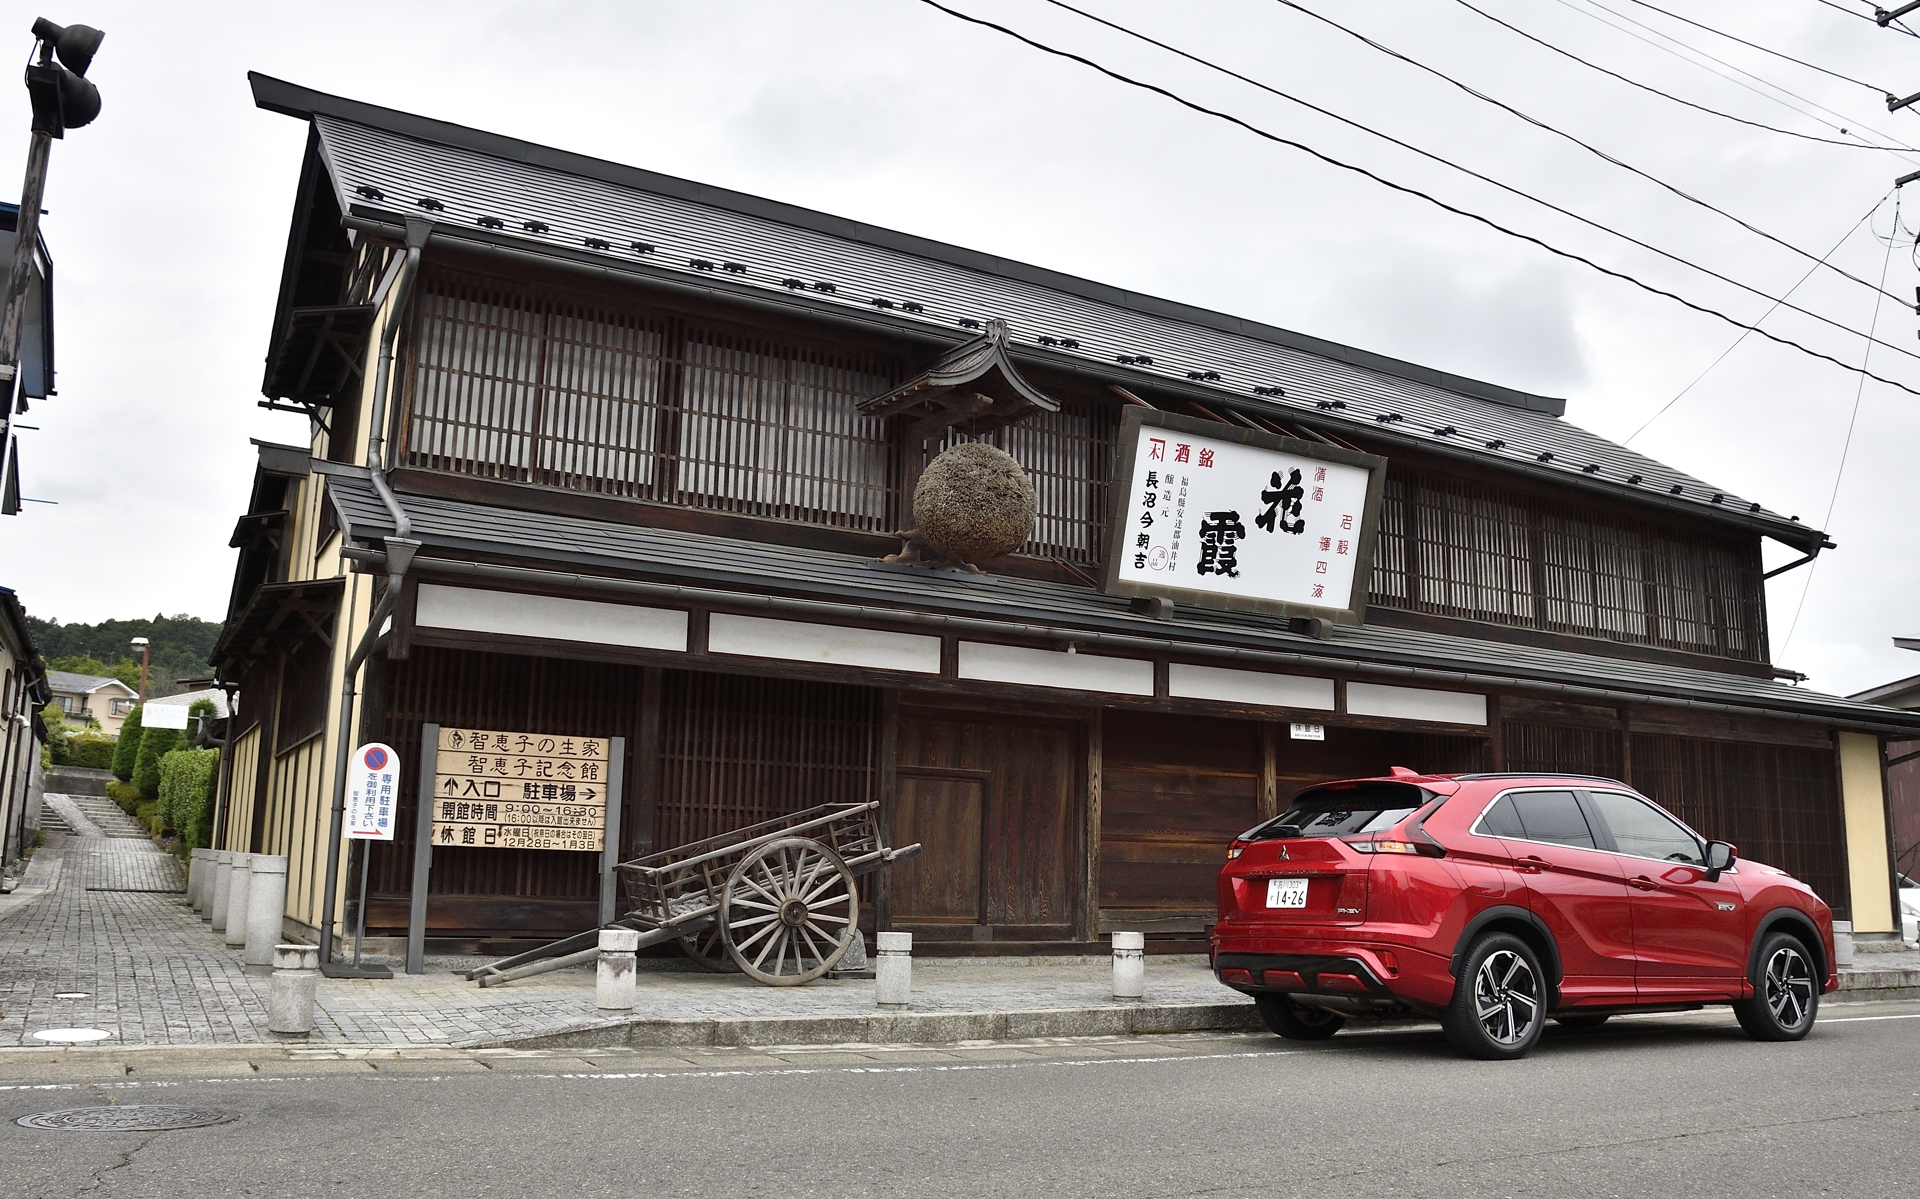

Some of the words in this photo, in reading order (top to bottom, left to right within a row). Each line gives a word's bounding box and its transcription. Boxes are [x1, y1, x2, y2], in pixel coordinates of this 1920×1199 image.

[1134, 470, 1160, 570] 長沼今朝吉
[469, 731, 600, 757] 智恵子の生家
[467, 755, 600, 781] 智恵子記念館
[362, 772, 378, 827] を御利用下さい
[377, 773, 392, 828] 専用駐車場
[462, 780, 500, 798] 入口
[522, 782, 576, 802] 駐車場
[441, 801, 498, 821] 開館時間
[440, 825, 496, 845] 休館日
